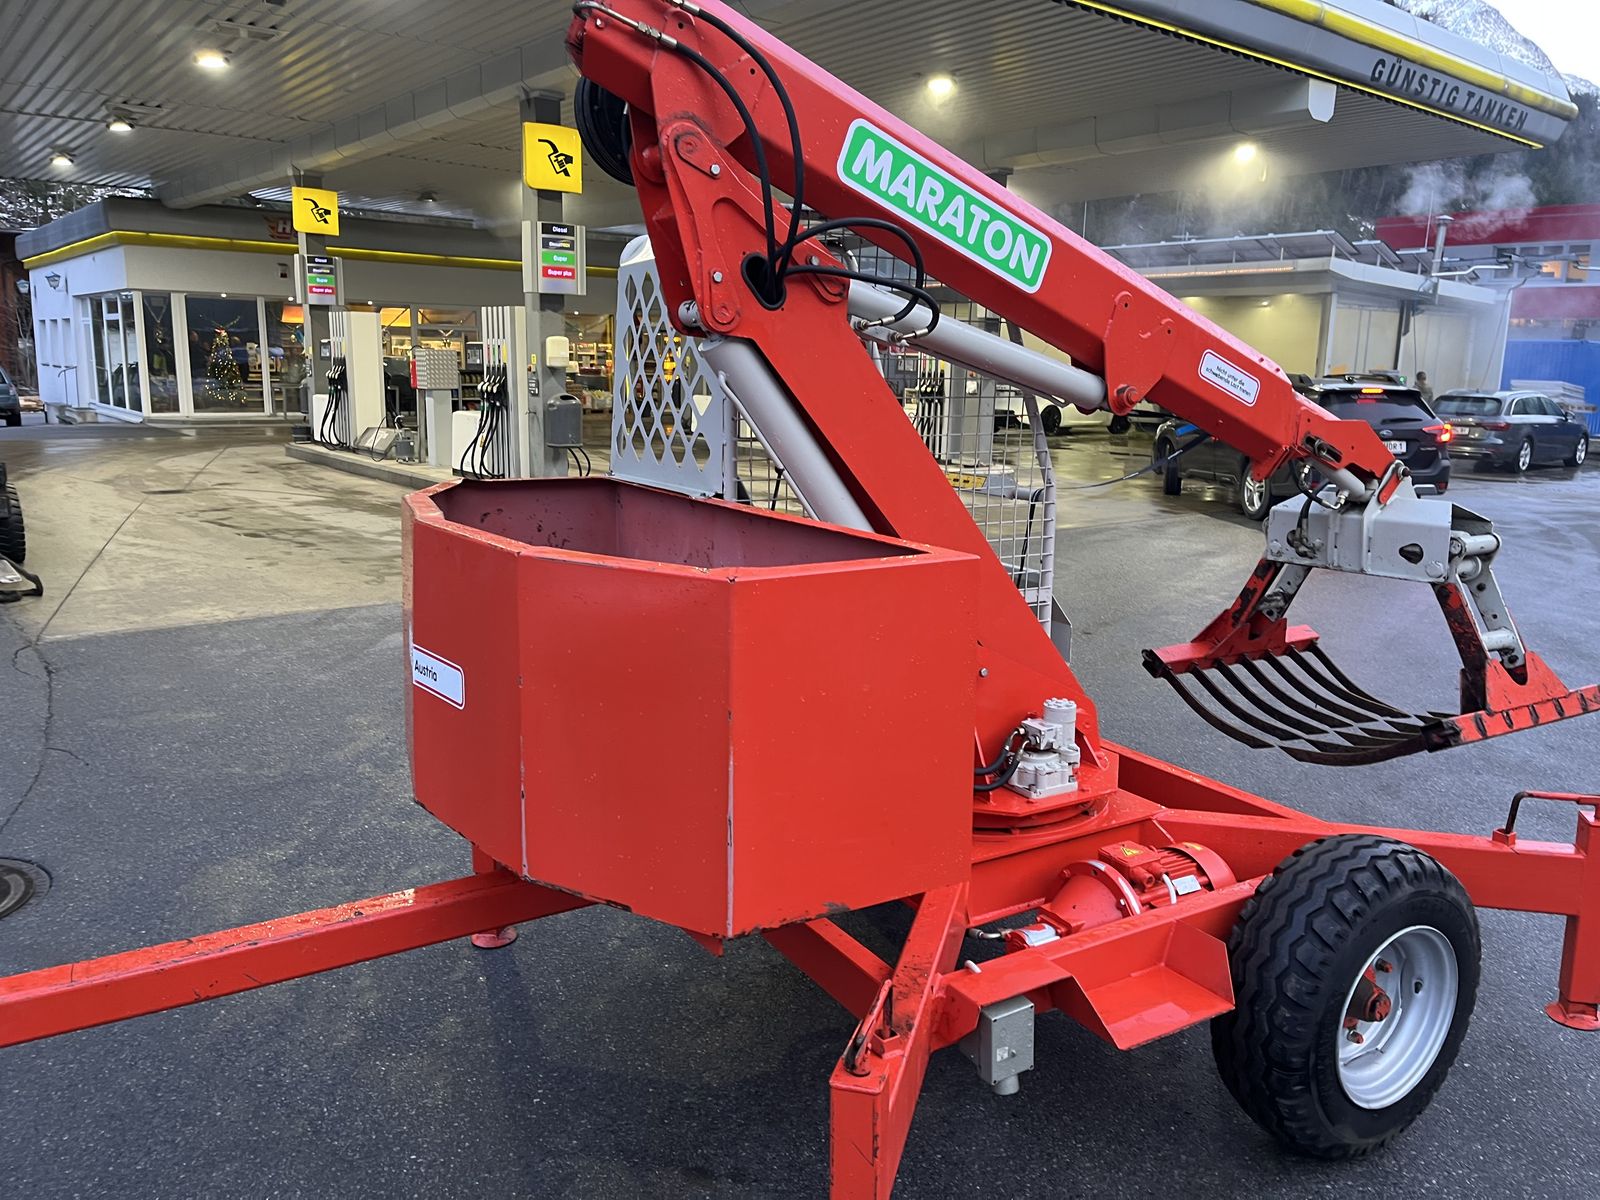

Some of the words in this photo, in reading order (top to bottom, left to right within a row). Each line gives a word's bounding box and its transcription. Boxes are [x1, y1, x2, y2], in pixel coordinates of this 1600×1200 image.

[1370, 58, 1460, 107] GÜNSTIG
[1462, 90, 1529, 130] TANKEN
[852, 138, 1040, 279] MARATON
[414, 660, 438, 682] Austria
